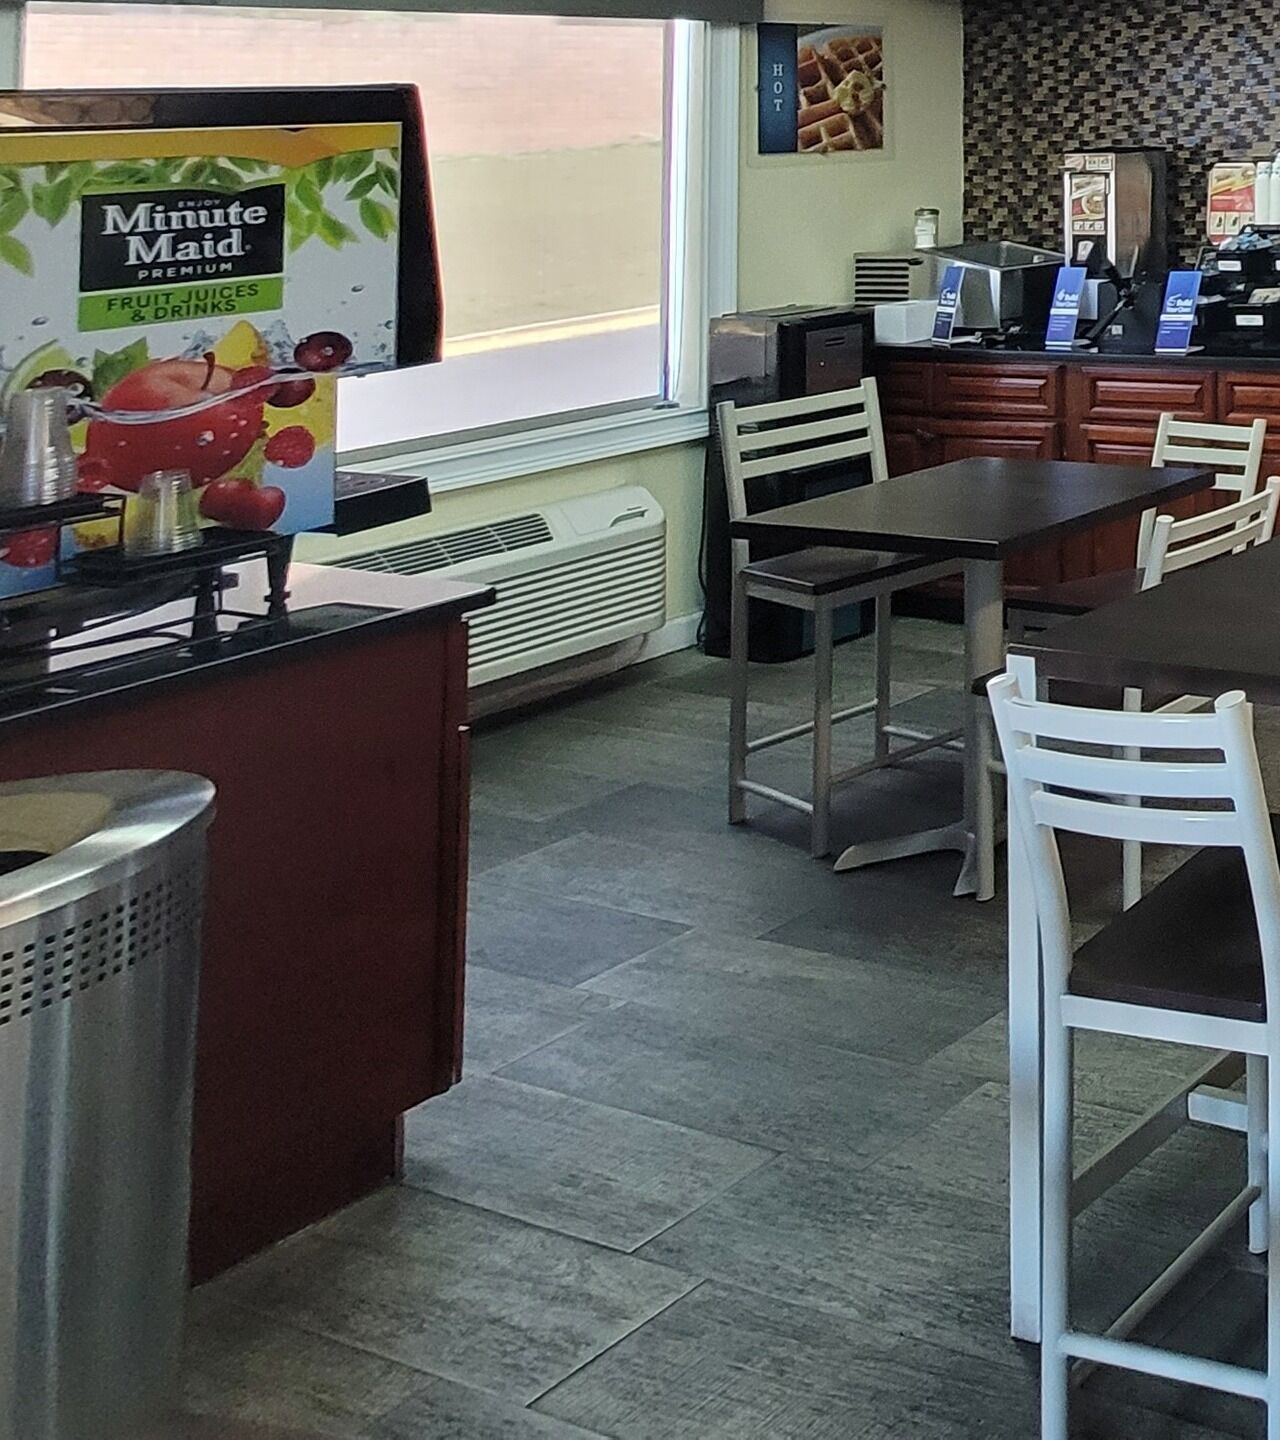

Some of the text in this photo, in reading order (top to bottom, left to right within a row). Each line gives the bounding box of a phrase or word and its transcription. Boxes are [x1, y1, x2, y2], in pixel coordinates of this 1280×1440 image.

[773, 63, 784, 112] HOT
[101, 200, 268, 235] Minute
[178, 199, 221, 208] ENJOY
[124, 228, 245, 266] Maid
[138, 262, 233, 280] PREMIUM
[107, 283, 259, 312] FRUIT JUICES
[131, 299, 236, 322] & DRINKS
